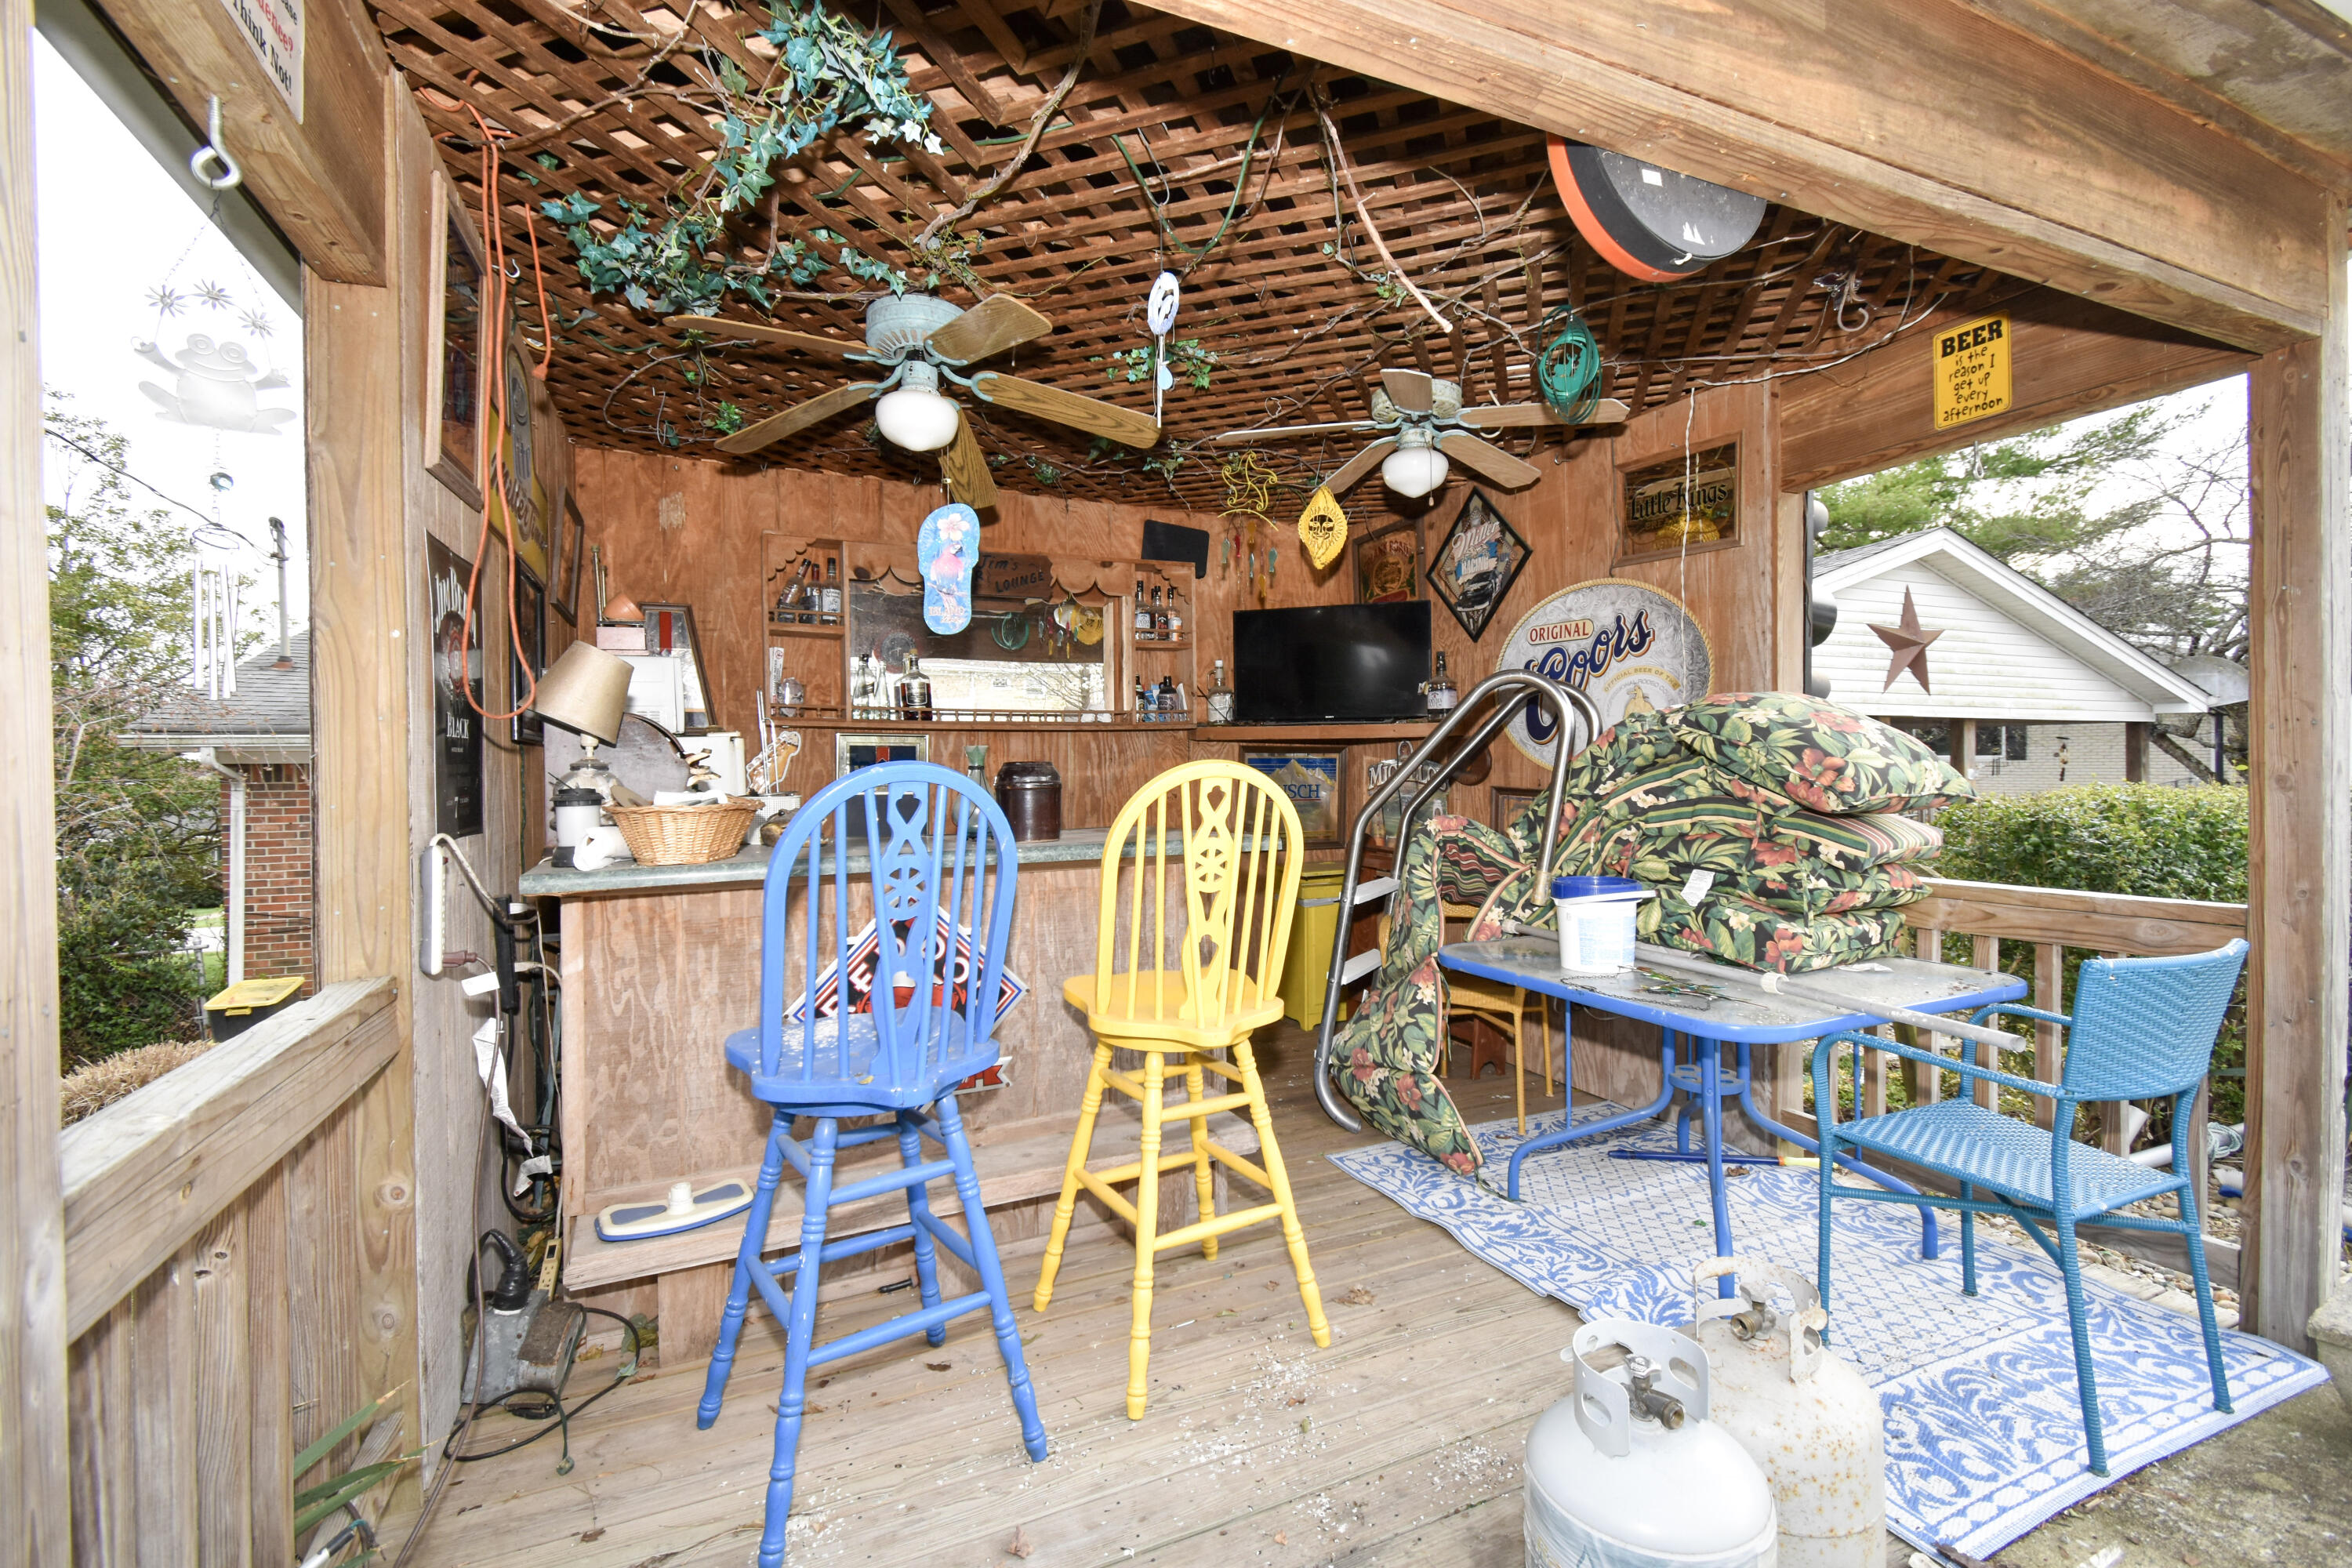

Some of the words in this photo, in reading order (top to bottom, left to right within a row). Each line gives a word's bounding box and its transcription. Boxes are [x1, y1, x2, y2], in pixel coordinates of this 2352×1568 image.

[270, 44, 292, 96] Not!
[1941, 319, 2003, 358] BEER
[1949, 363, 1984, 383] reason
[1989, 354, 1995, 368] I
[1955, 354, 1963, 366] is
[1967, 347, 1987, 363] the
[1954, 379, 1973, 396] get
[1978, 372, 1991, 387] up
[1943, 397, 2003, 422] afternoon
[1956, 390, 1988, 405] every
[1632, 489, 1671, 521] Little
[1452, 521, 1501, 563] Miller
[982, 554, 1018, 570] Jim's
[1461, 554, 1490, 575] RACING
[995, 571, 1044, 593] LOUNGE
[1530, 622, 1589, 642] ORIGINAL
[1525, 608, 1655, 745] Coors
[1605, 670, 1632, 691] OFFICIAL
[446, 712, 470, 739] BLACK
[1280, 784, 1320, 799] USCH
